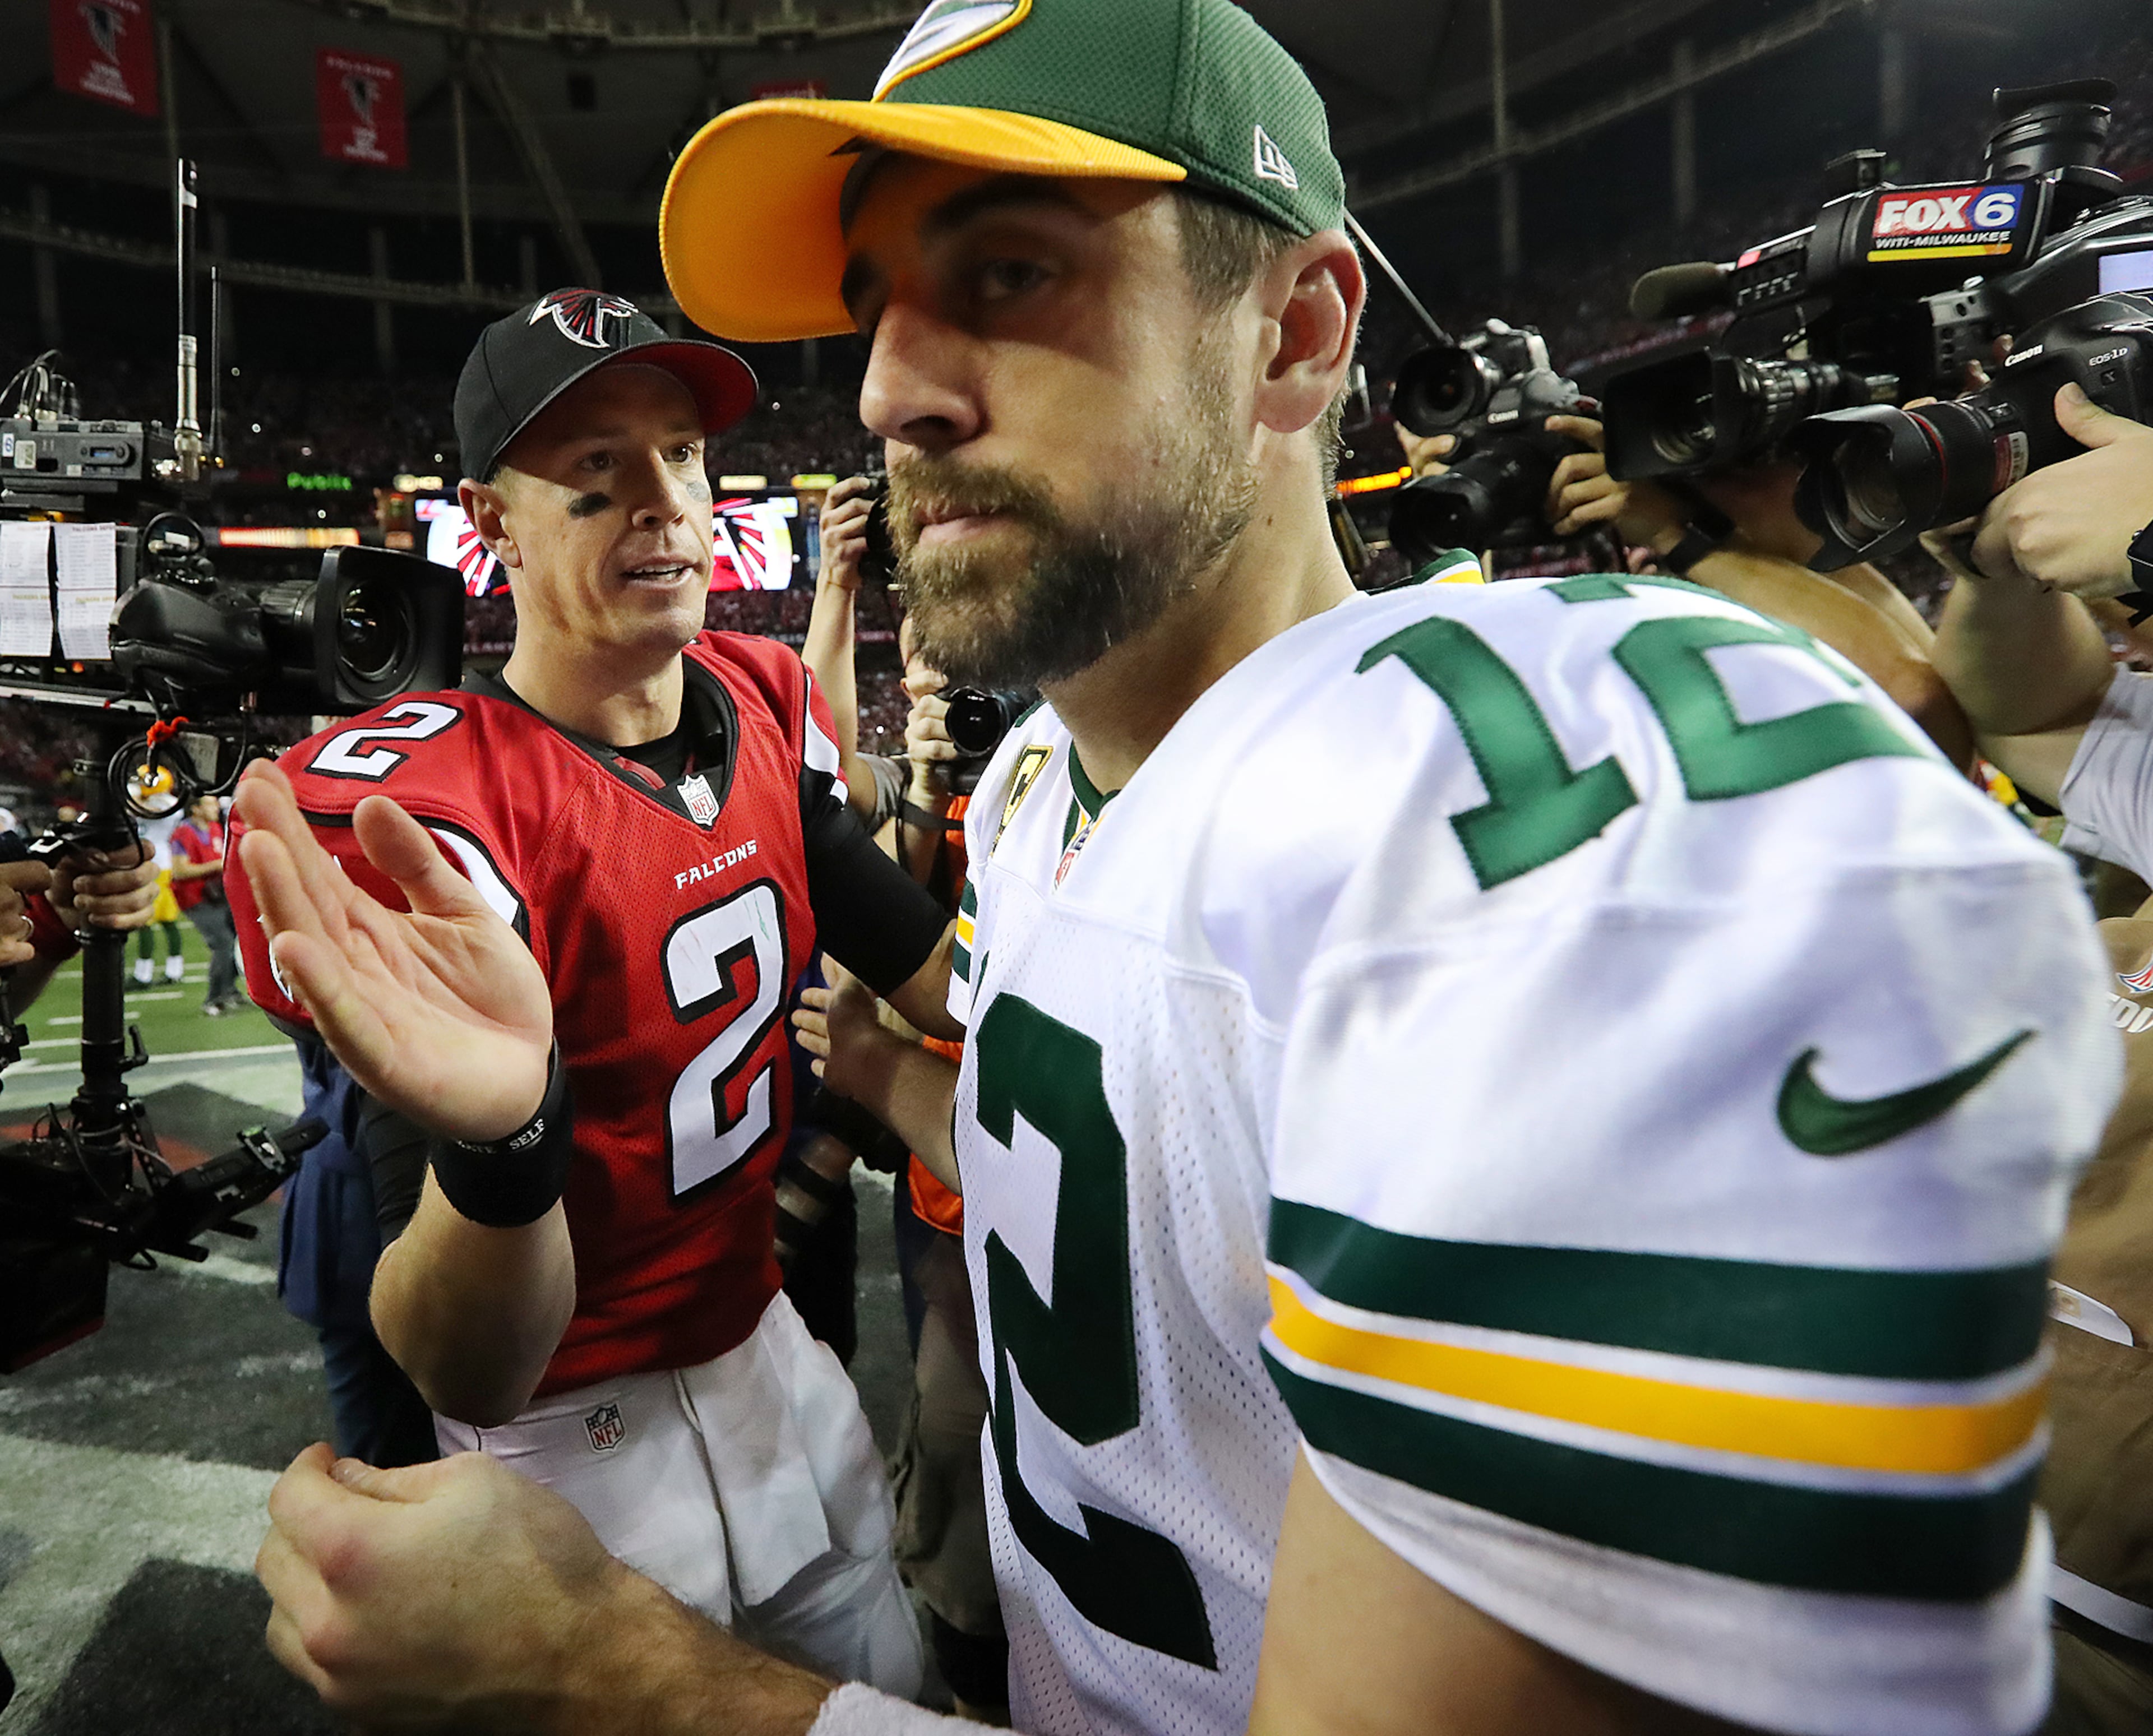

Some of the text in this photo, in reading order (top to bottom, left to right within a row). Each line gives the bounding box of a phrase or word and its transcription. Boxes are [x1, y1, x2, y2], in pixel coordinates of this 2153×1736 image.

[1878, 192, 2016, 234] FOX 6
[1875, 230, 2011, 249] WITI-MILWAUKEE
[2004, 344, 2044, 367] Canon
[1487, 409, 1519, 424] Canon
[303, 700, 465, 783] 2
[1353, 573, 1930, 892] 12
[691, 795, 714, 817] NFL
[673, 839, 757, 890] FALCONS
[661, 878, 788, 1204] 2
[509, 1118, 546, 1150] SELF
[971, 950, 1218, 1671] 2
[593, 1421, 622, 1446] NFL
